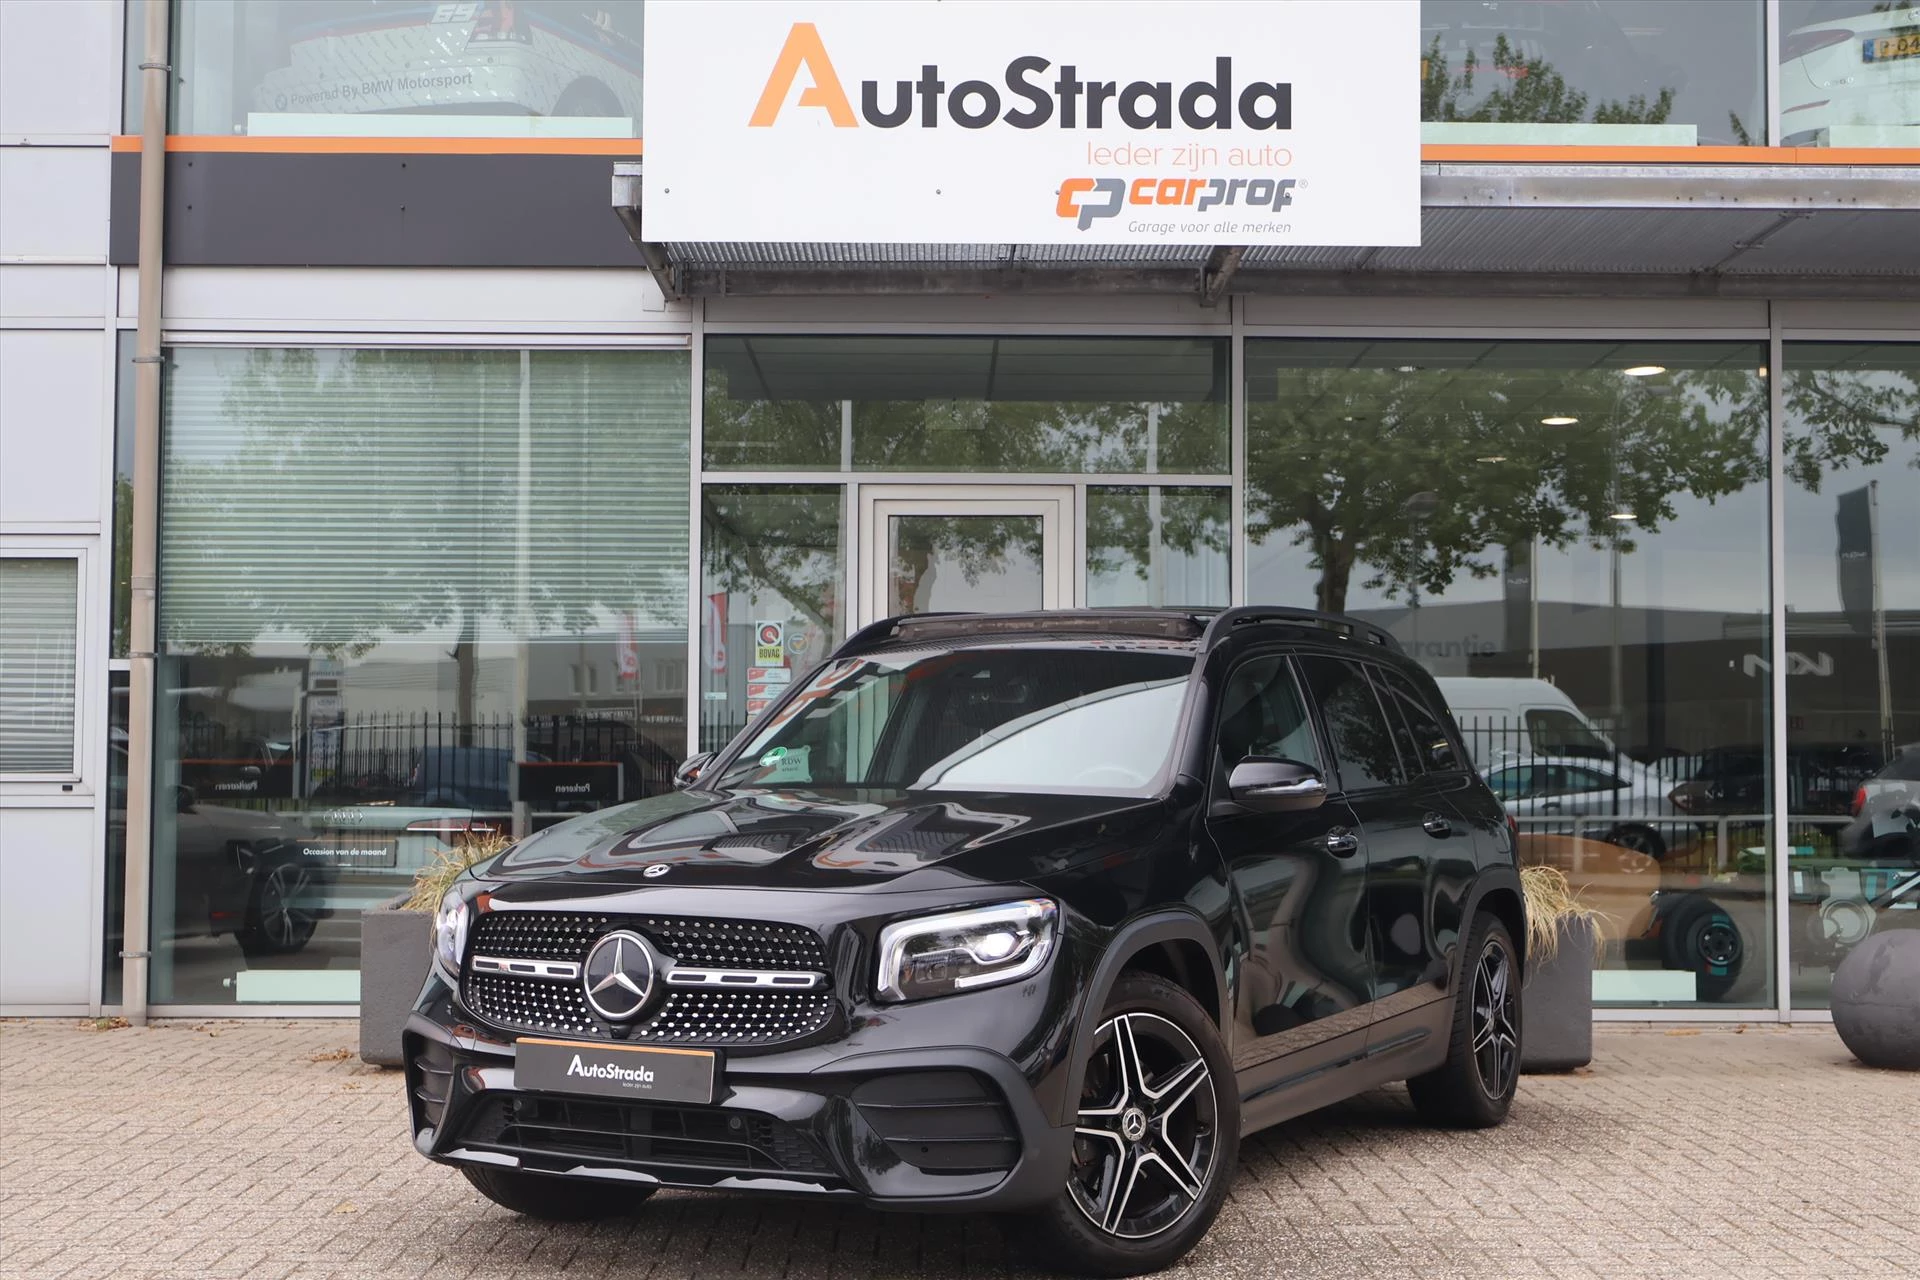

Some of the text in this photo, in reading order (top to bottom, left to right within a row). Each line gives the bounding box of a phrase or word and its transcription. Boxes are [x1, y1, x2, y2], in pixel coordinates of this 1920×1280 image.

[291, 72, 473, 105] Powered By BMW Motorsport
[747, 22, 1292, 130] AutoStrada
[1087, 142, 1292, 172] Ieder zijn auto
[1128, 220, 1292, 236] Garage voor alle merken
[759, 648, 780, 659] BOVAG
[1399, 632, 1497, 657] arantie
[781, 757, 802, 767] RDW
[303, 847, 387, 856] Occasion van de maand
[567, 1054, 654, 1082] AutoStrada
